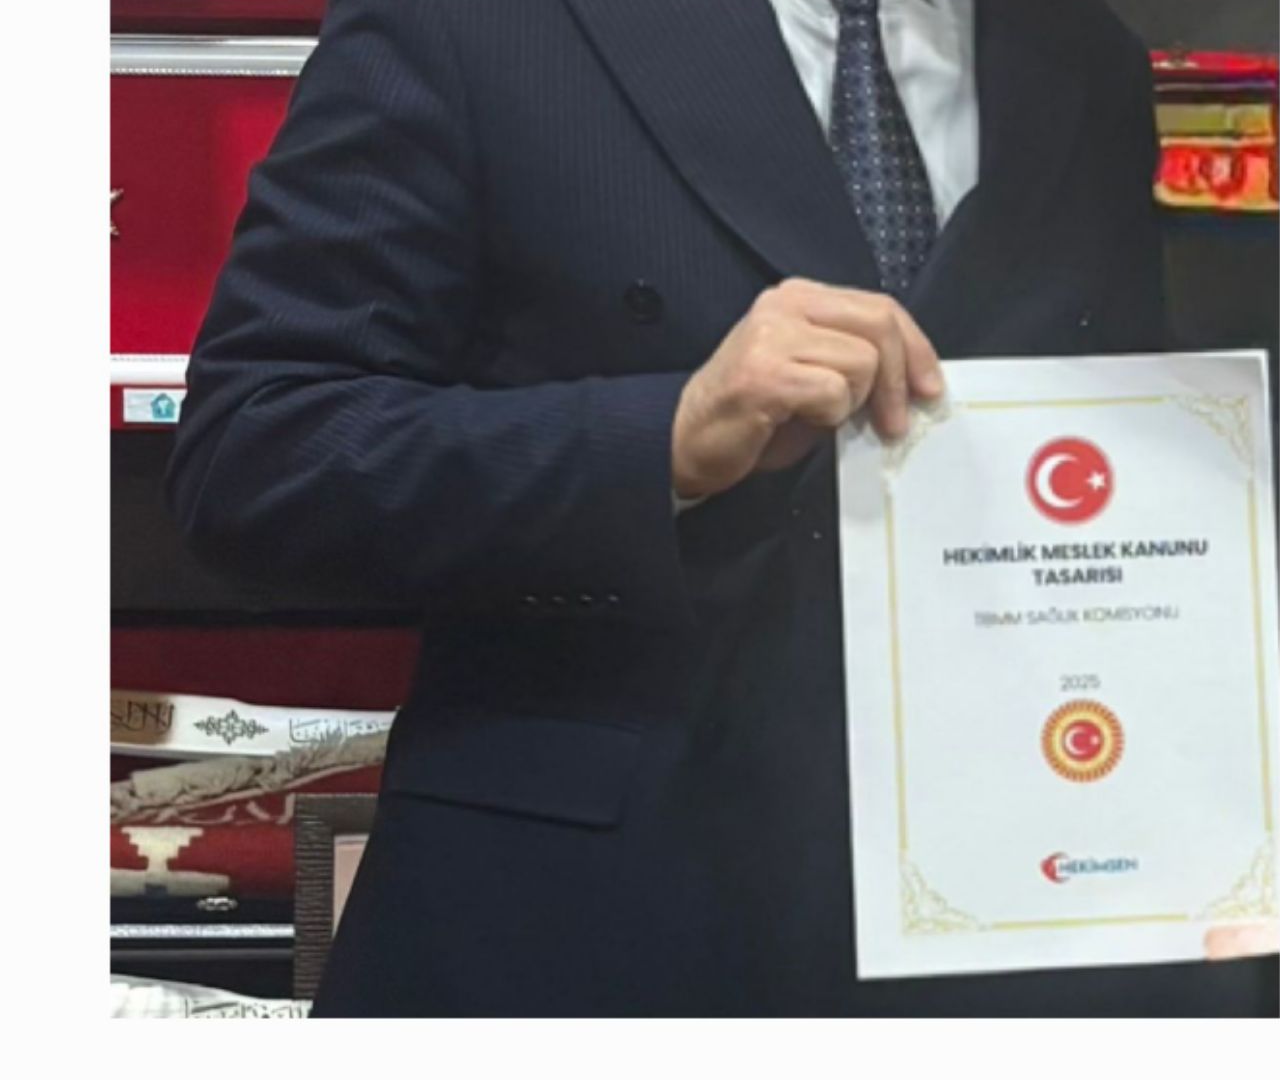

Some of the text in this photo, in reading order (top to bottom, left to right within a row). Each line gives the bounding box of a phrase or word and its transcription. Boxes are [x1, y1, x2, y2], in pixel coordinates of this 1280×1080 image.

[943, 539, 1209, 566] HEKİMLİK MESLEK KANUNU
[1032, 566, 1124, 587] TASARISI
[1059, 674, 1101, 692] 2025
